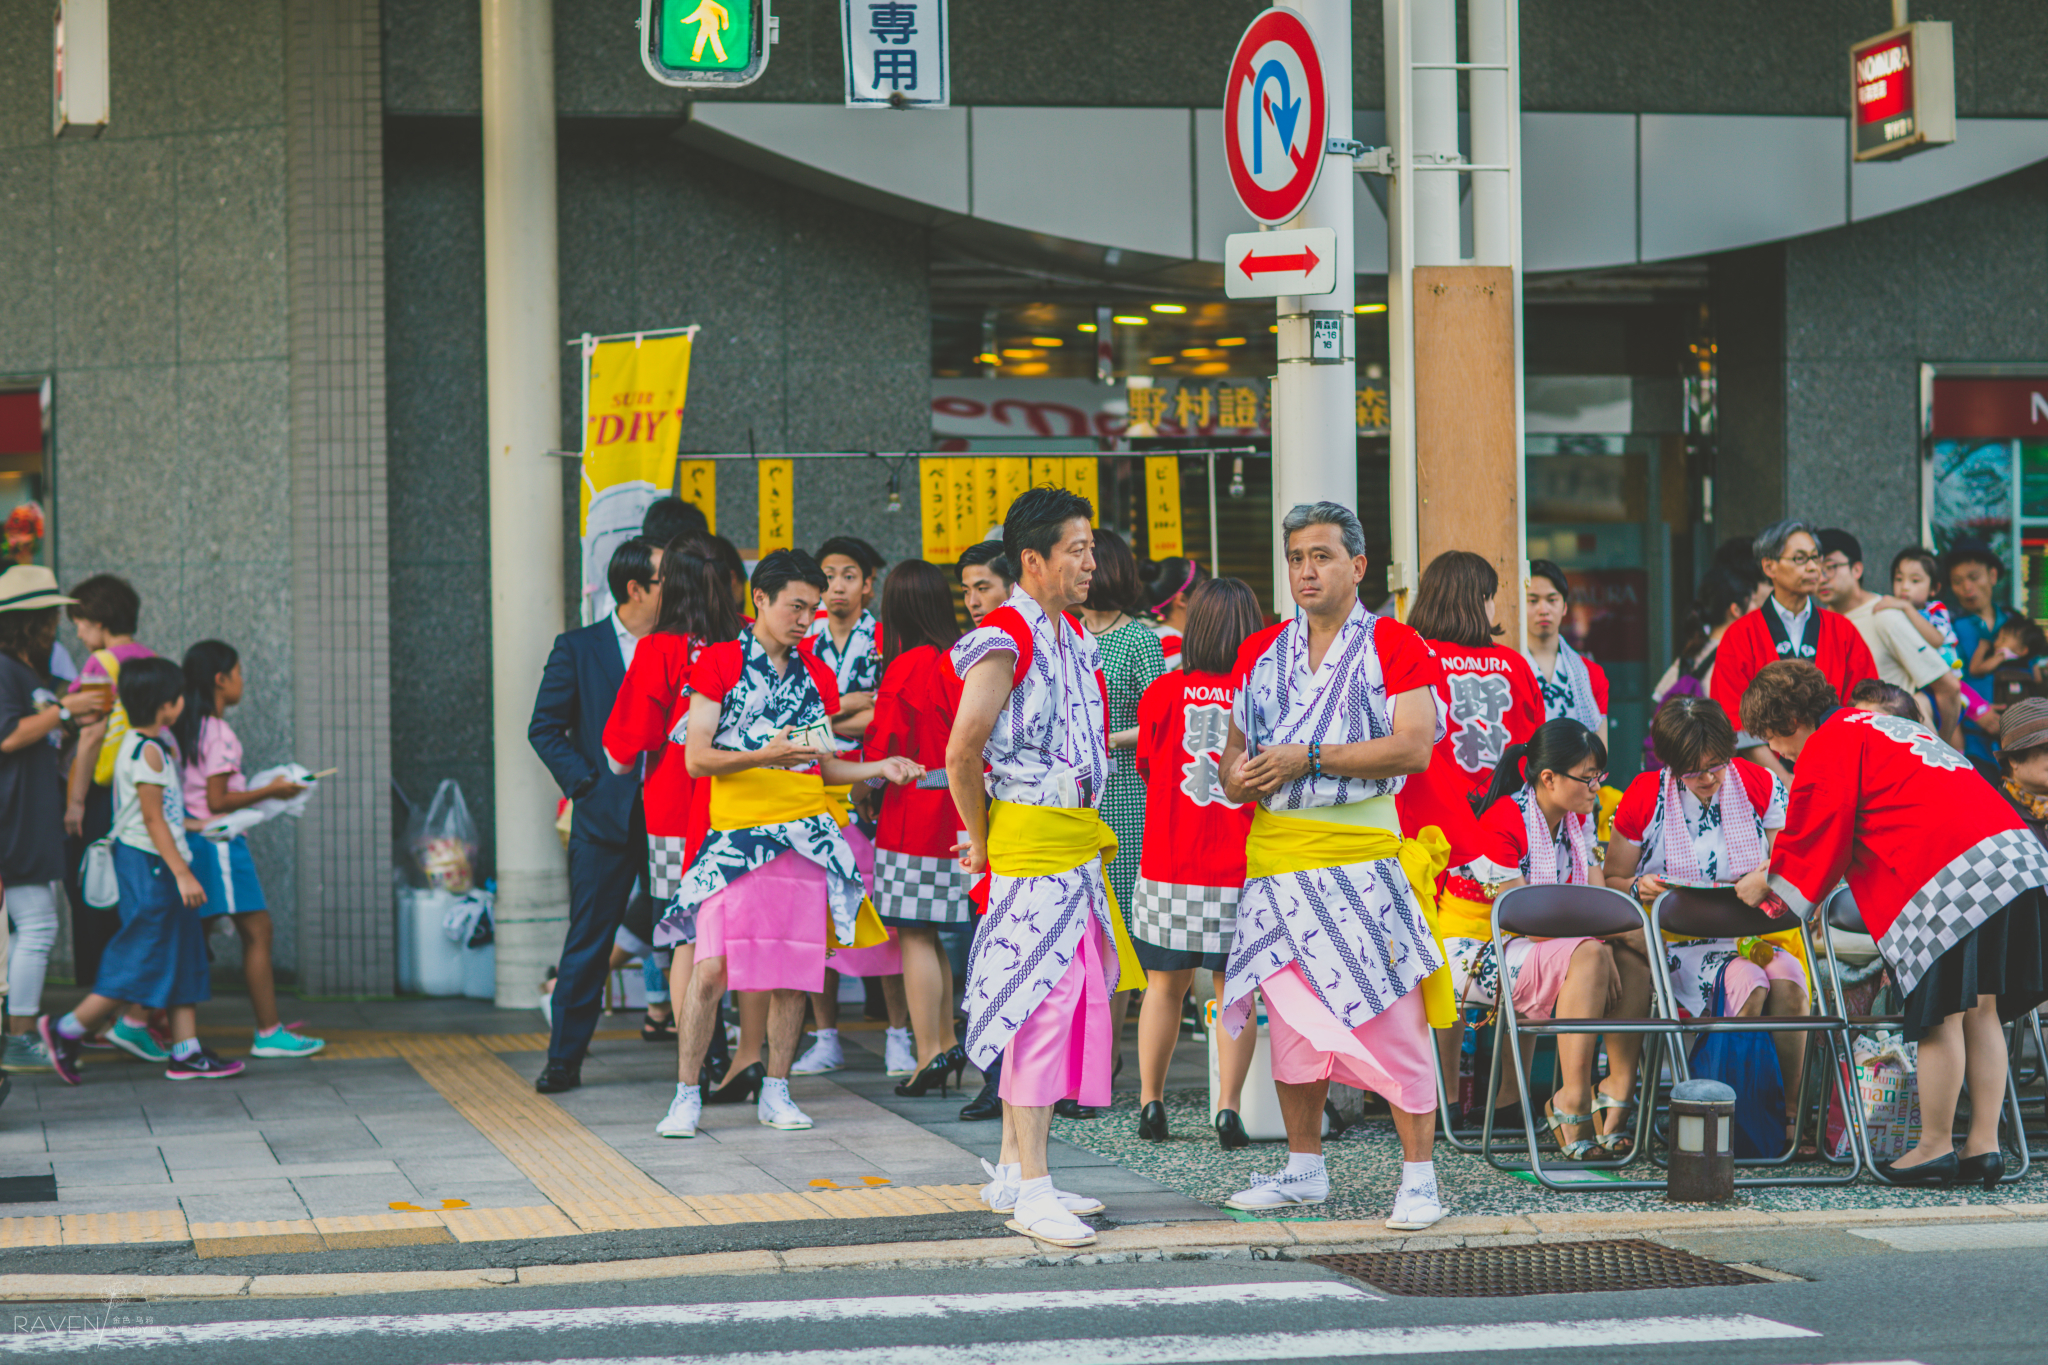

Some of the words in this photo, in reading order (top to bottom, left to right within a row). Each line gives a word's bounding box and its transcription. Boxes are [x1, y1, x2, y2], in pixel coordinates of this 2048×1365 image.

[868, 1, 918, 91] 専用
[1857, 44, 1911, 85] NOMURA
[1314, 330, 1337, 339] A-16
[1322, 340, 1332, 349] 16
[1127, 386, 1271, 430] 野村證
[768, 466, 784, 539] やきそば
[1155, 465, 1170, 513] ビール
[1440, 656, 1513, 673] NOMURA
[1448, 673, 1512, 772] 野村
